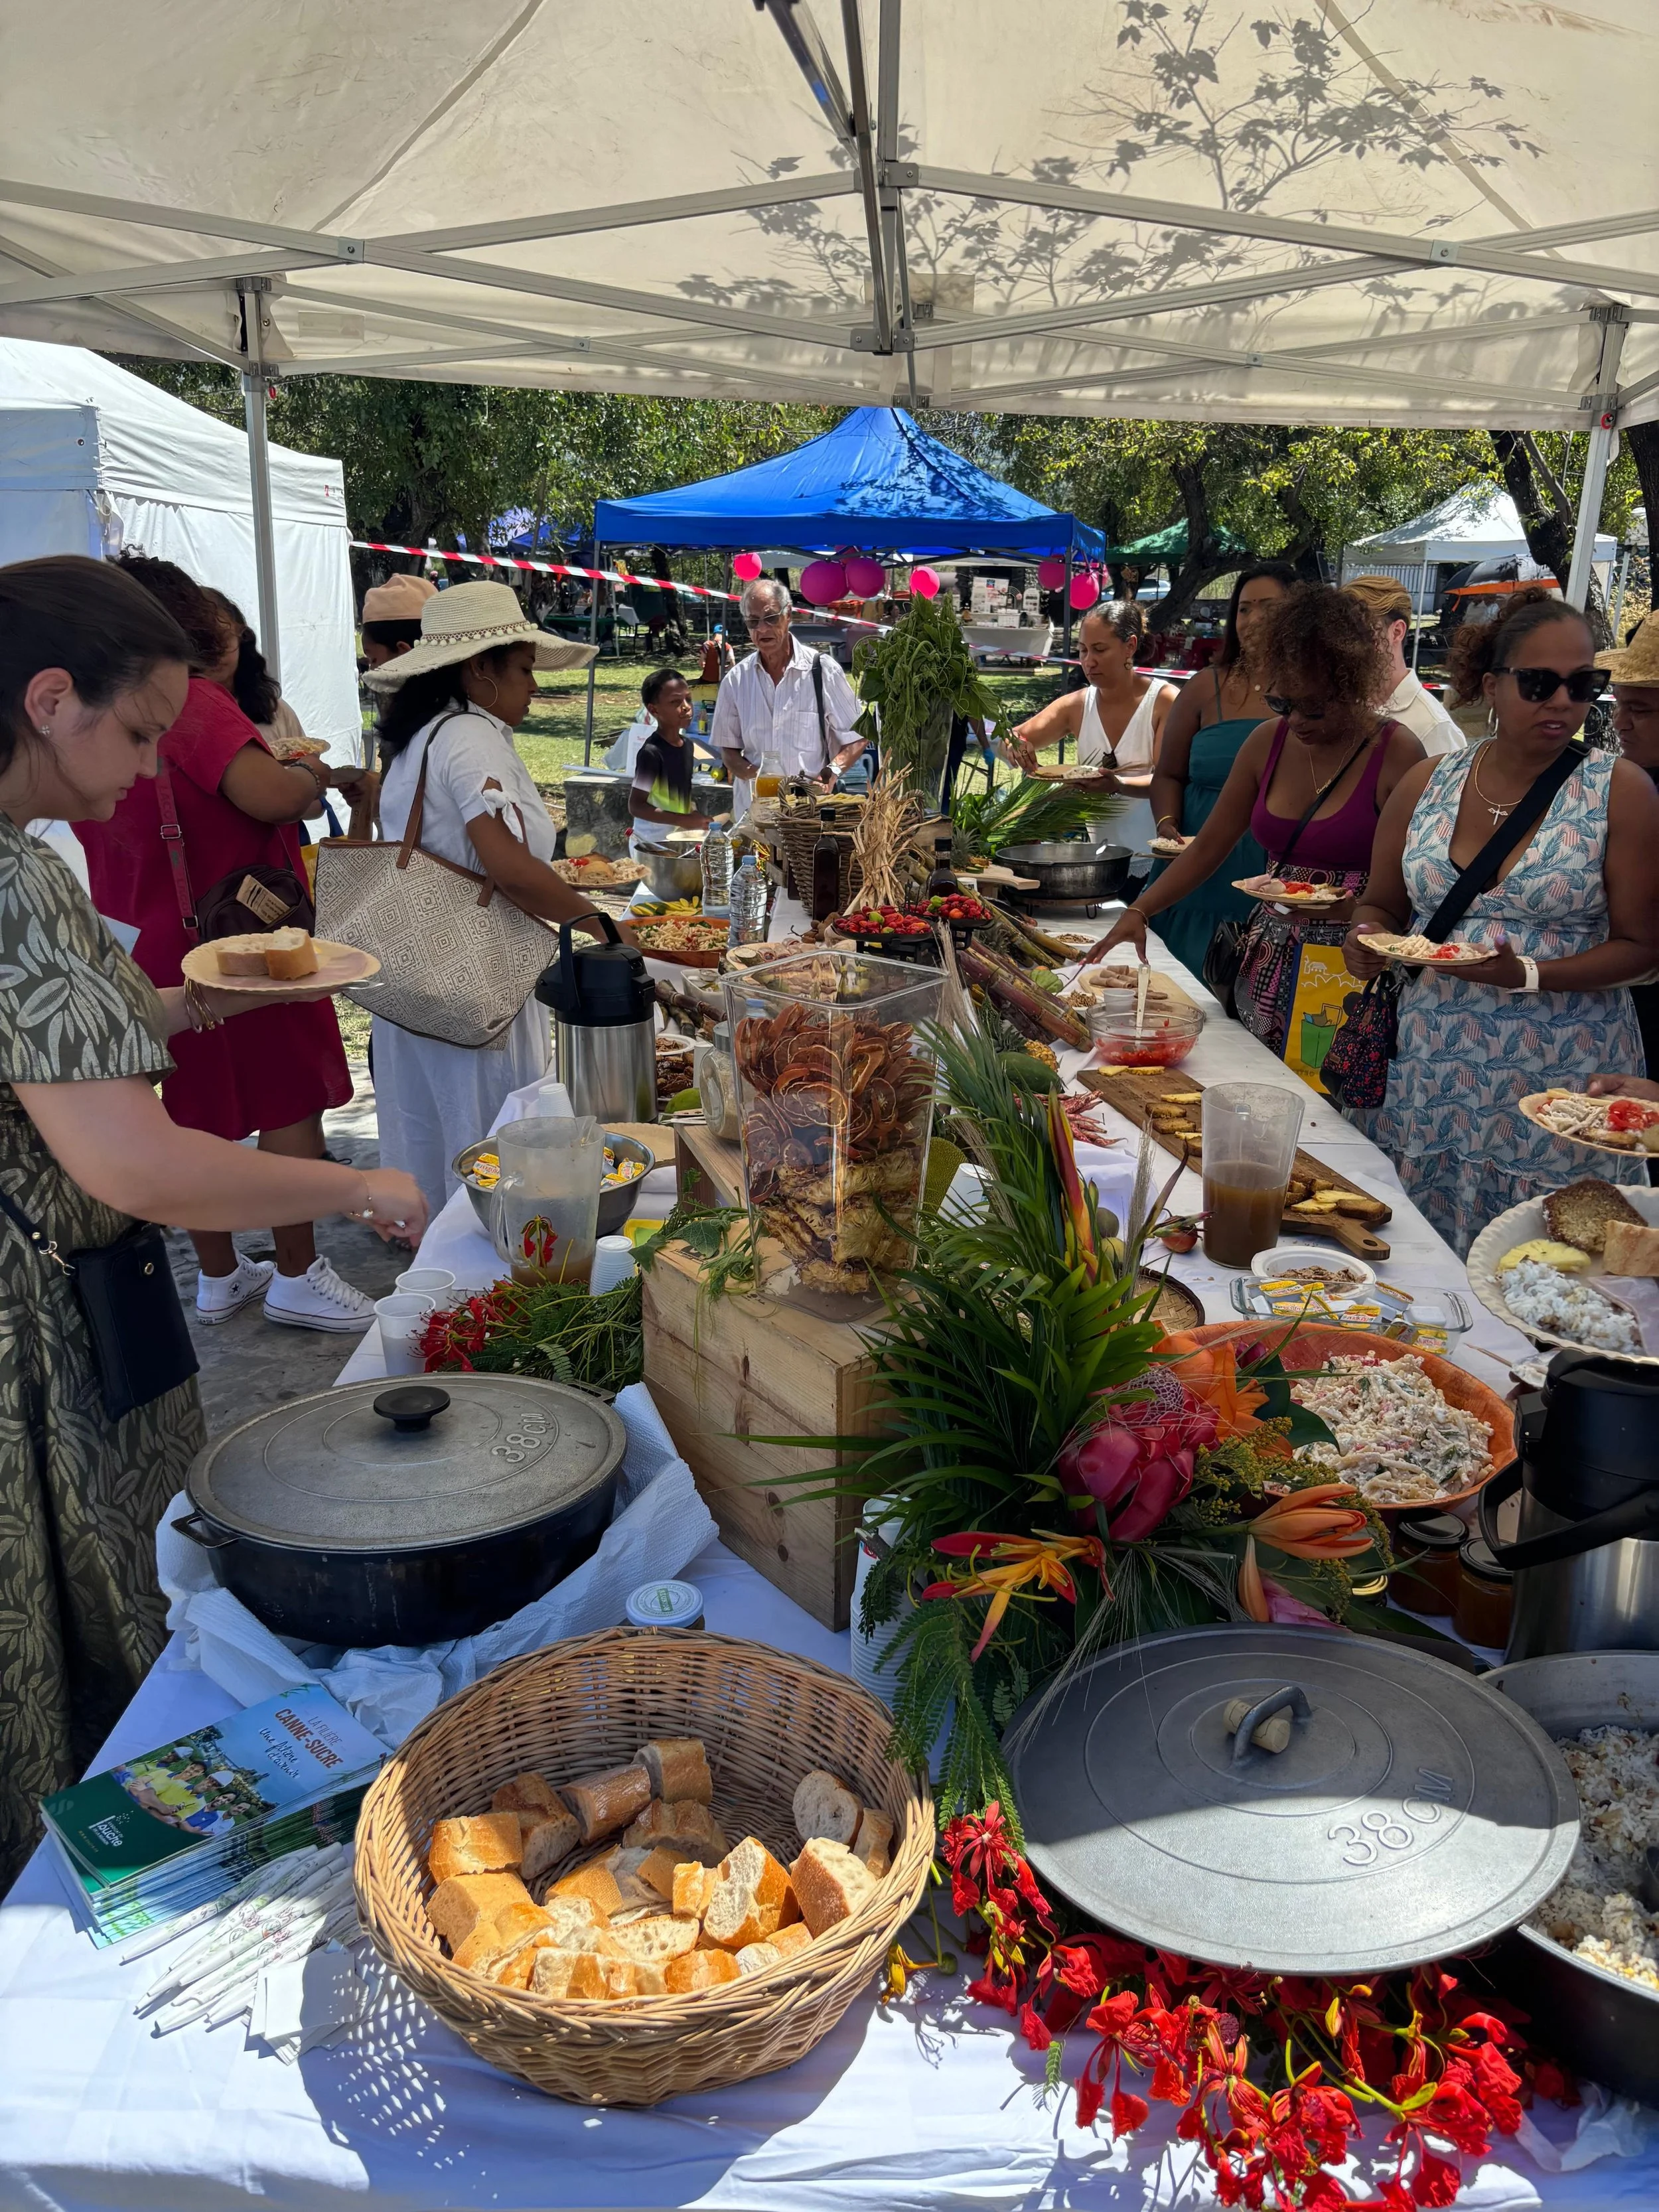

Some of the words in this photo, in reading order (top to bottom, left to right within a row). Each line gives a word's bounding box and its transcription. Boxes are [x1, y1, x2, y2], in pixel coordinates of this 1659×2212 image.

[491, 1433, 541, 1463] 38
[259, 1728, 276, 1743] Une
[275, 1708, 344, 1769] CANNE-SUCRE
[308, 1716, 323, 1727] LA
[316, 1725, 343, 1747] FILIÈRE
[264, 1741, 299, 1764] filière
[267, 1752, 301, 1779] d'avenir
[1327, 1809, 1415, 1866] 38
[1402, 1767, 1455, 1824] CM
